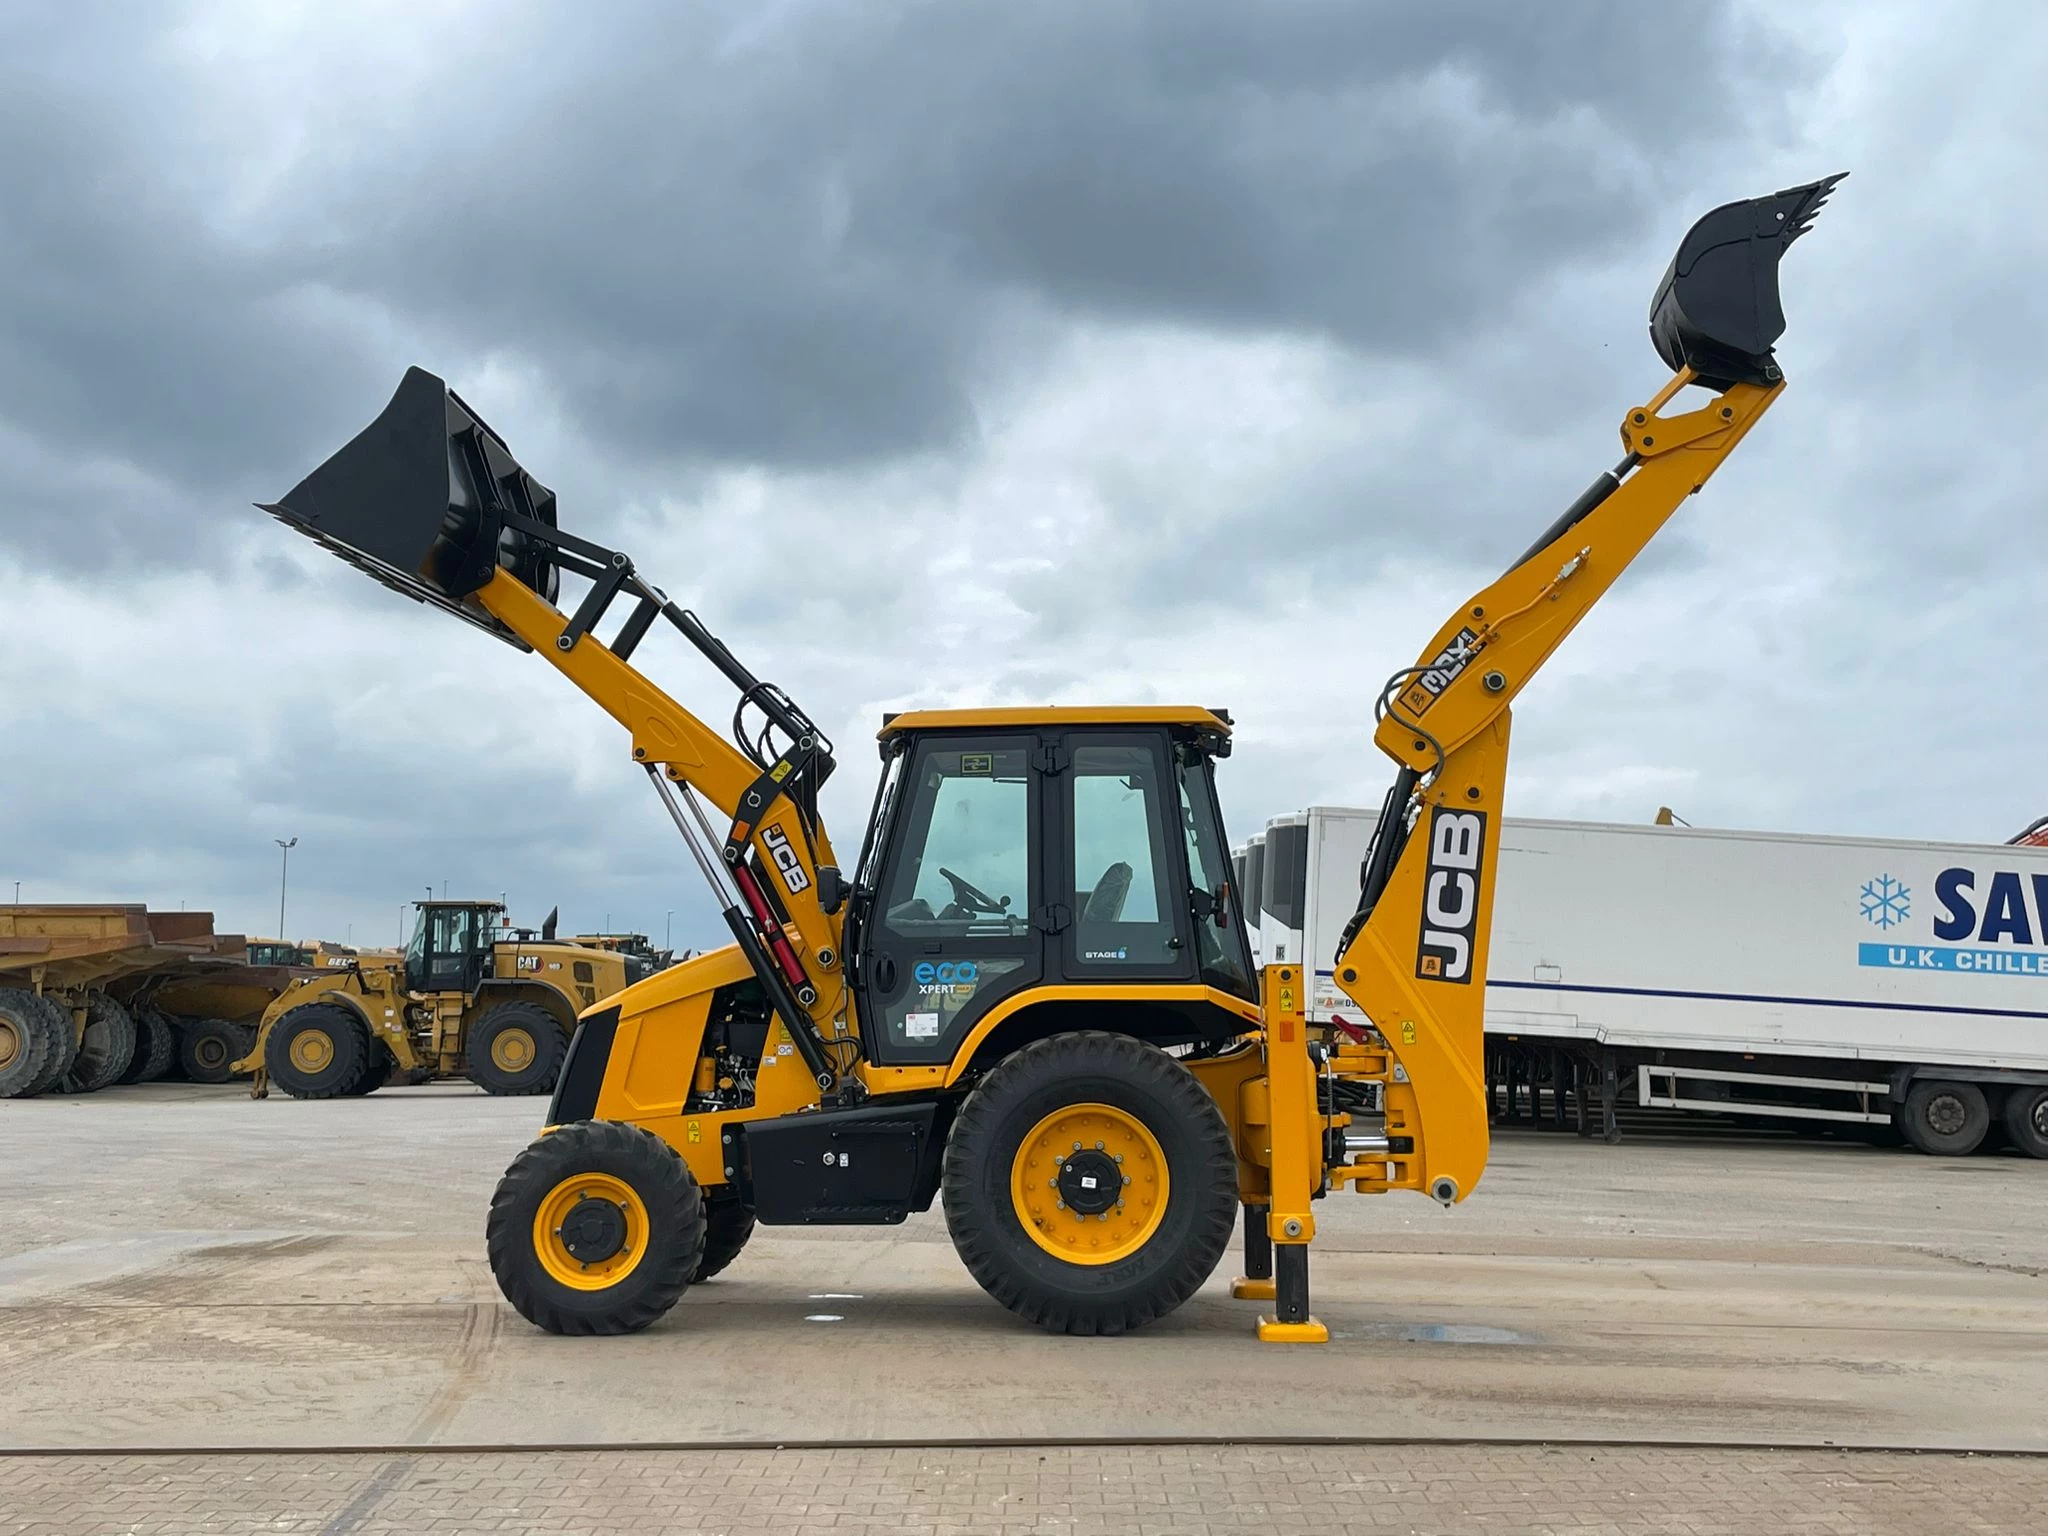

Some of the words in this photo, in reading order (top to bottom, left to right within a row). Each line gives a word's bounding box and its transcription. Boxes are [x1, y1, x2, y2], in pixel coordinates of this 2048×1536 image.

[763, 829, 808, 893] JCB
[1424, 813, 1481, 979] JCB
[518, 956, 538, 970] CAT
[914, 961, 977, 984] eco
[1888, 948, 1943, 968] U.K.
[1955, 952, 2048, 973] CHILLE
[919, 984, 955, 994] XPERT
